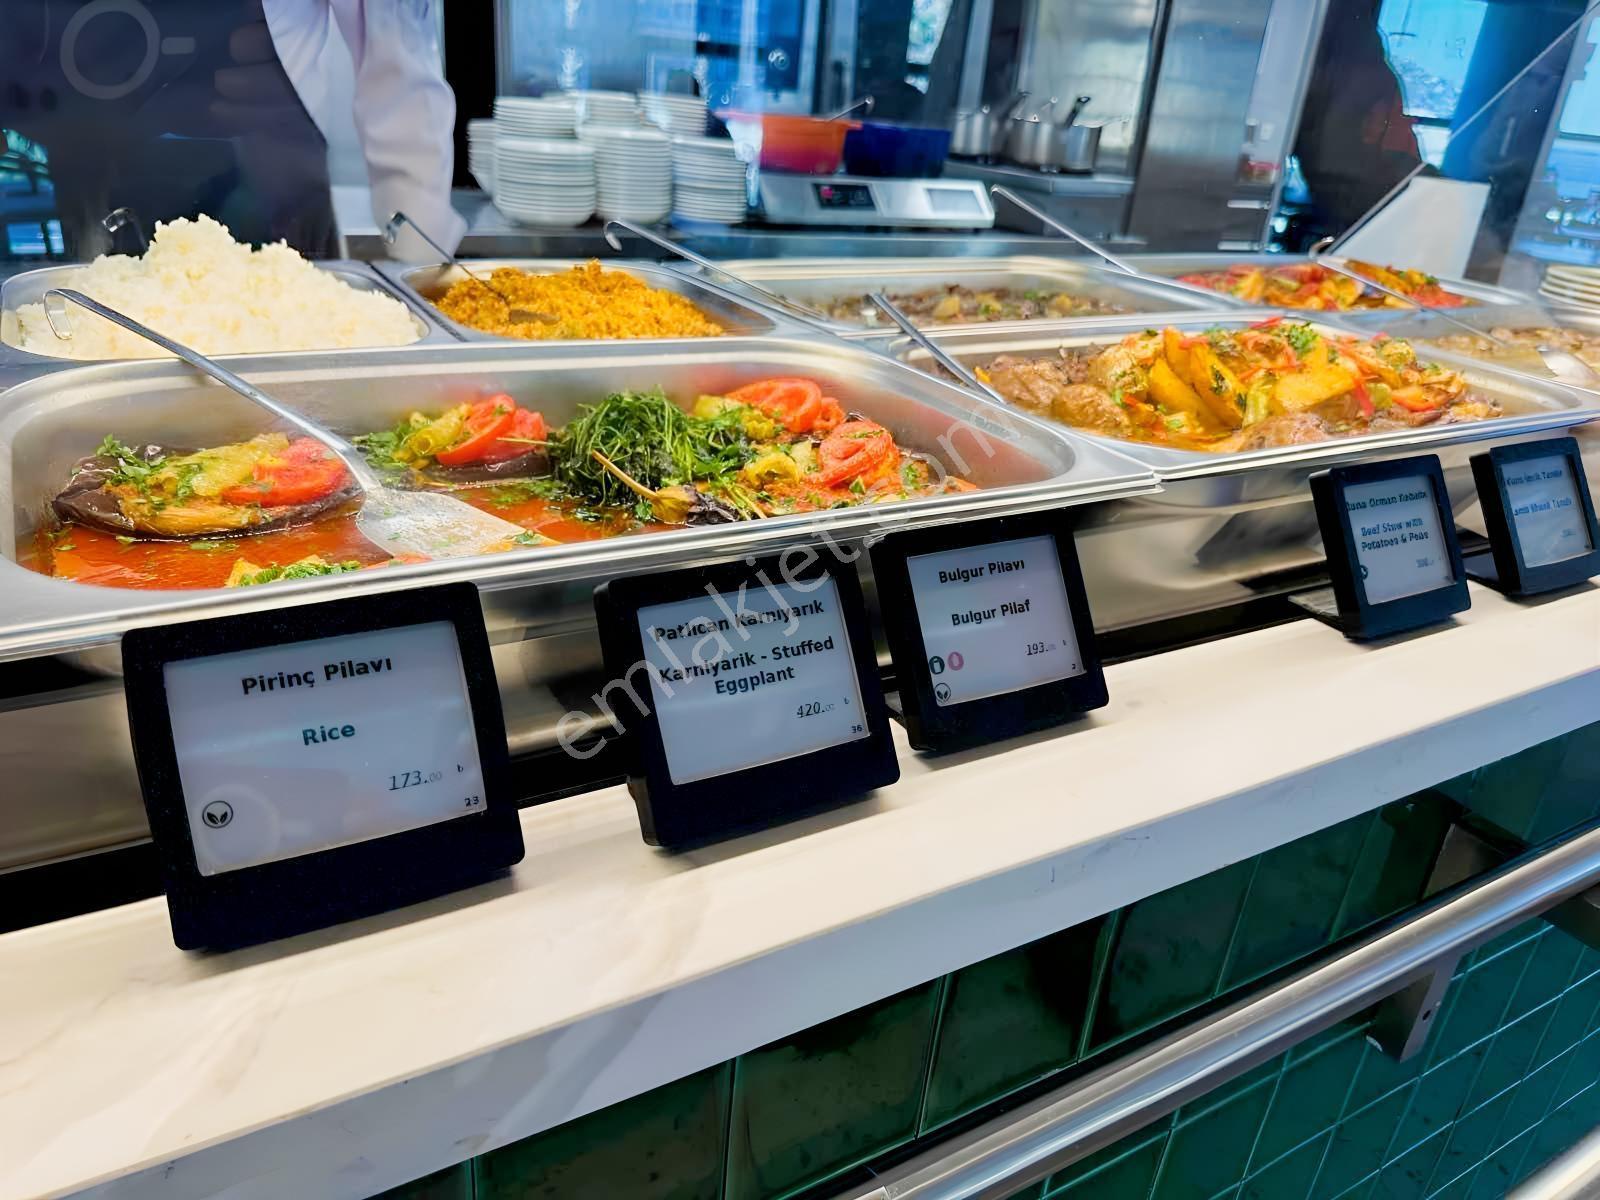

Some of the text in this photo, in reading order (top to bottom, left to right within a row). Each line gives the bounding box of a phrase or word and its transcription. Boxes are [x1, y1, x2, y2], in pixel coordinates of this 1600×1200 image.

[938, 559, 1025, 583] Bulgur Pilavı
[951, 598, 1031, 626] Bulgur Pilaf
[772, 636, 835, 661] Stuffed
[241, 657, 393, 695] Pirinç Pilavı
[715, 665, 796, 696] Eggplant
[302, 723, 356, 746] Rice
